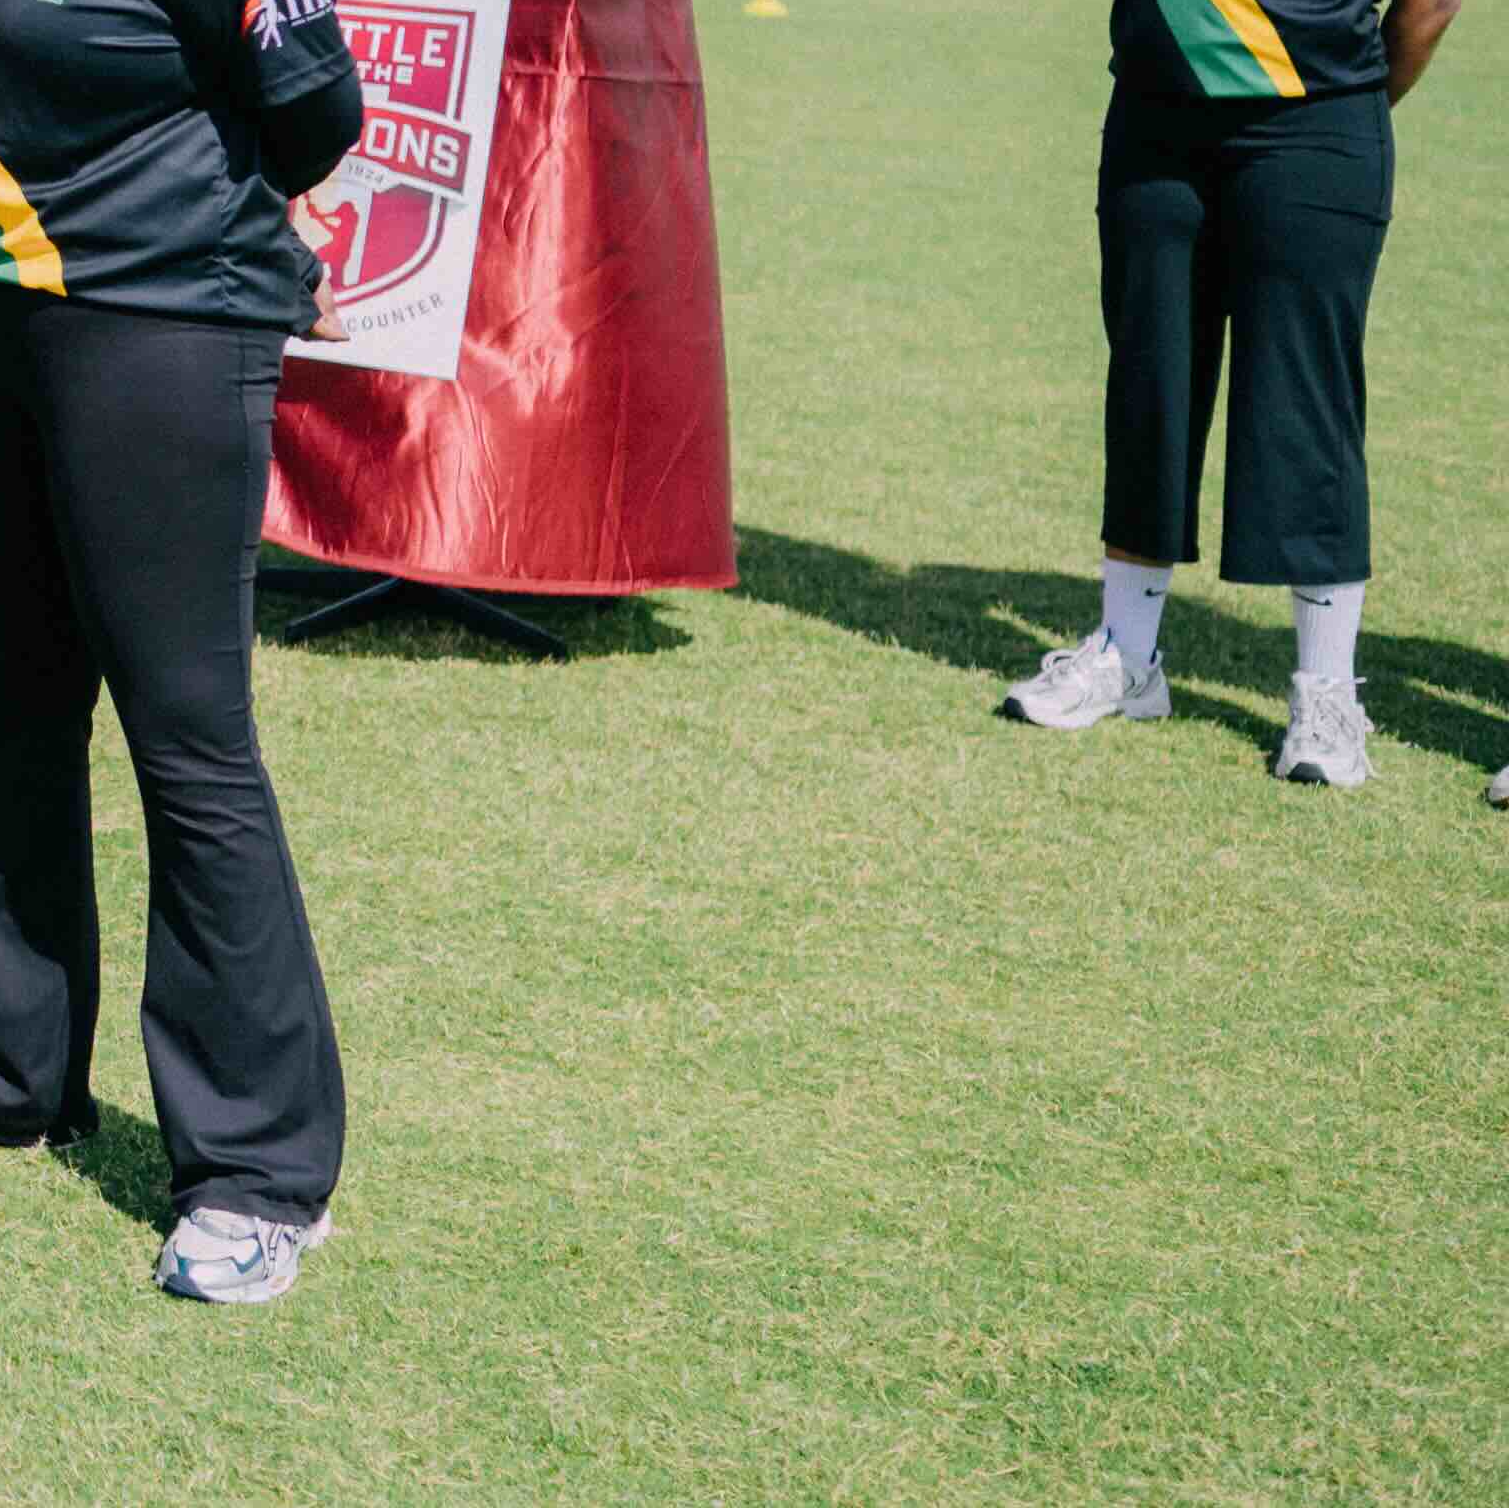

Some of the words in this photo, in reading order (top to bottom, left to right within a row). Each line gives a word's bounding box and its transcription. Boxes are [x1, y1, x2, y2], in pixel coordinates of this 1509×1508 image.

[356, 60, 415, 85] THE
[357, 117, 460, 180] ONS
[345, 293, 444, 333] COUNTER
